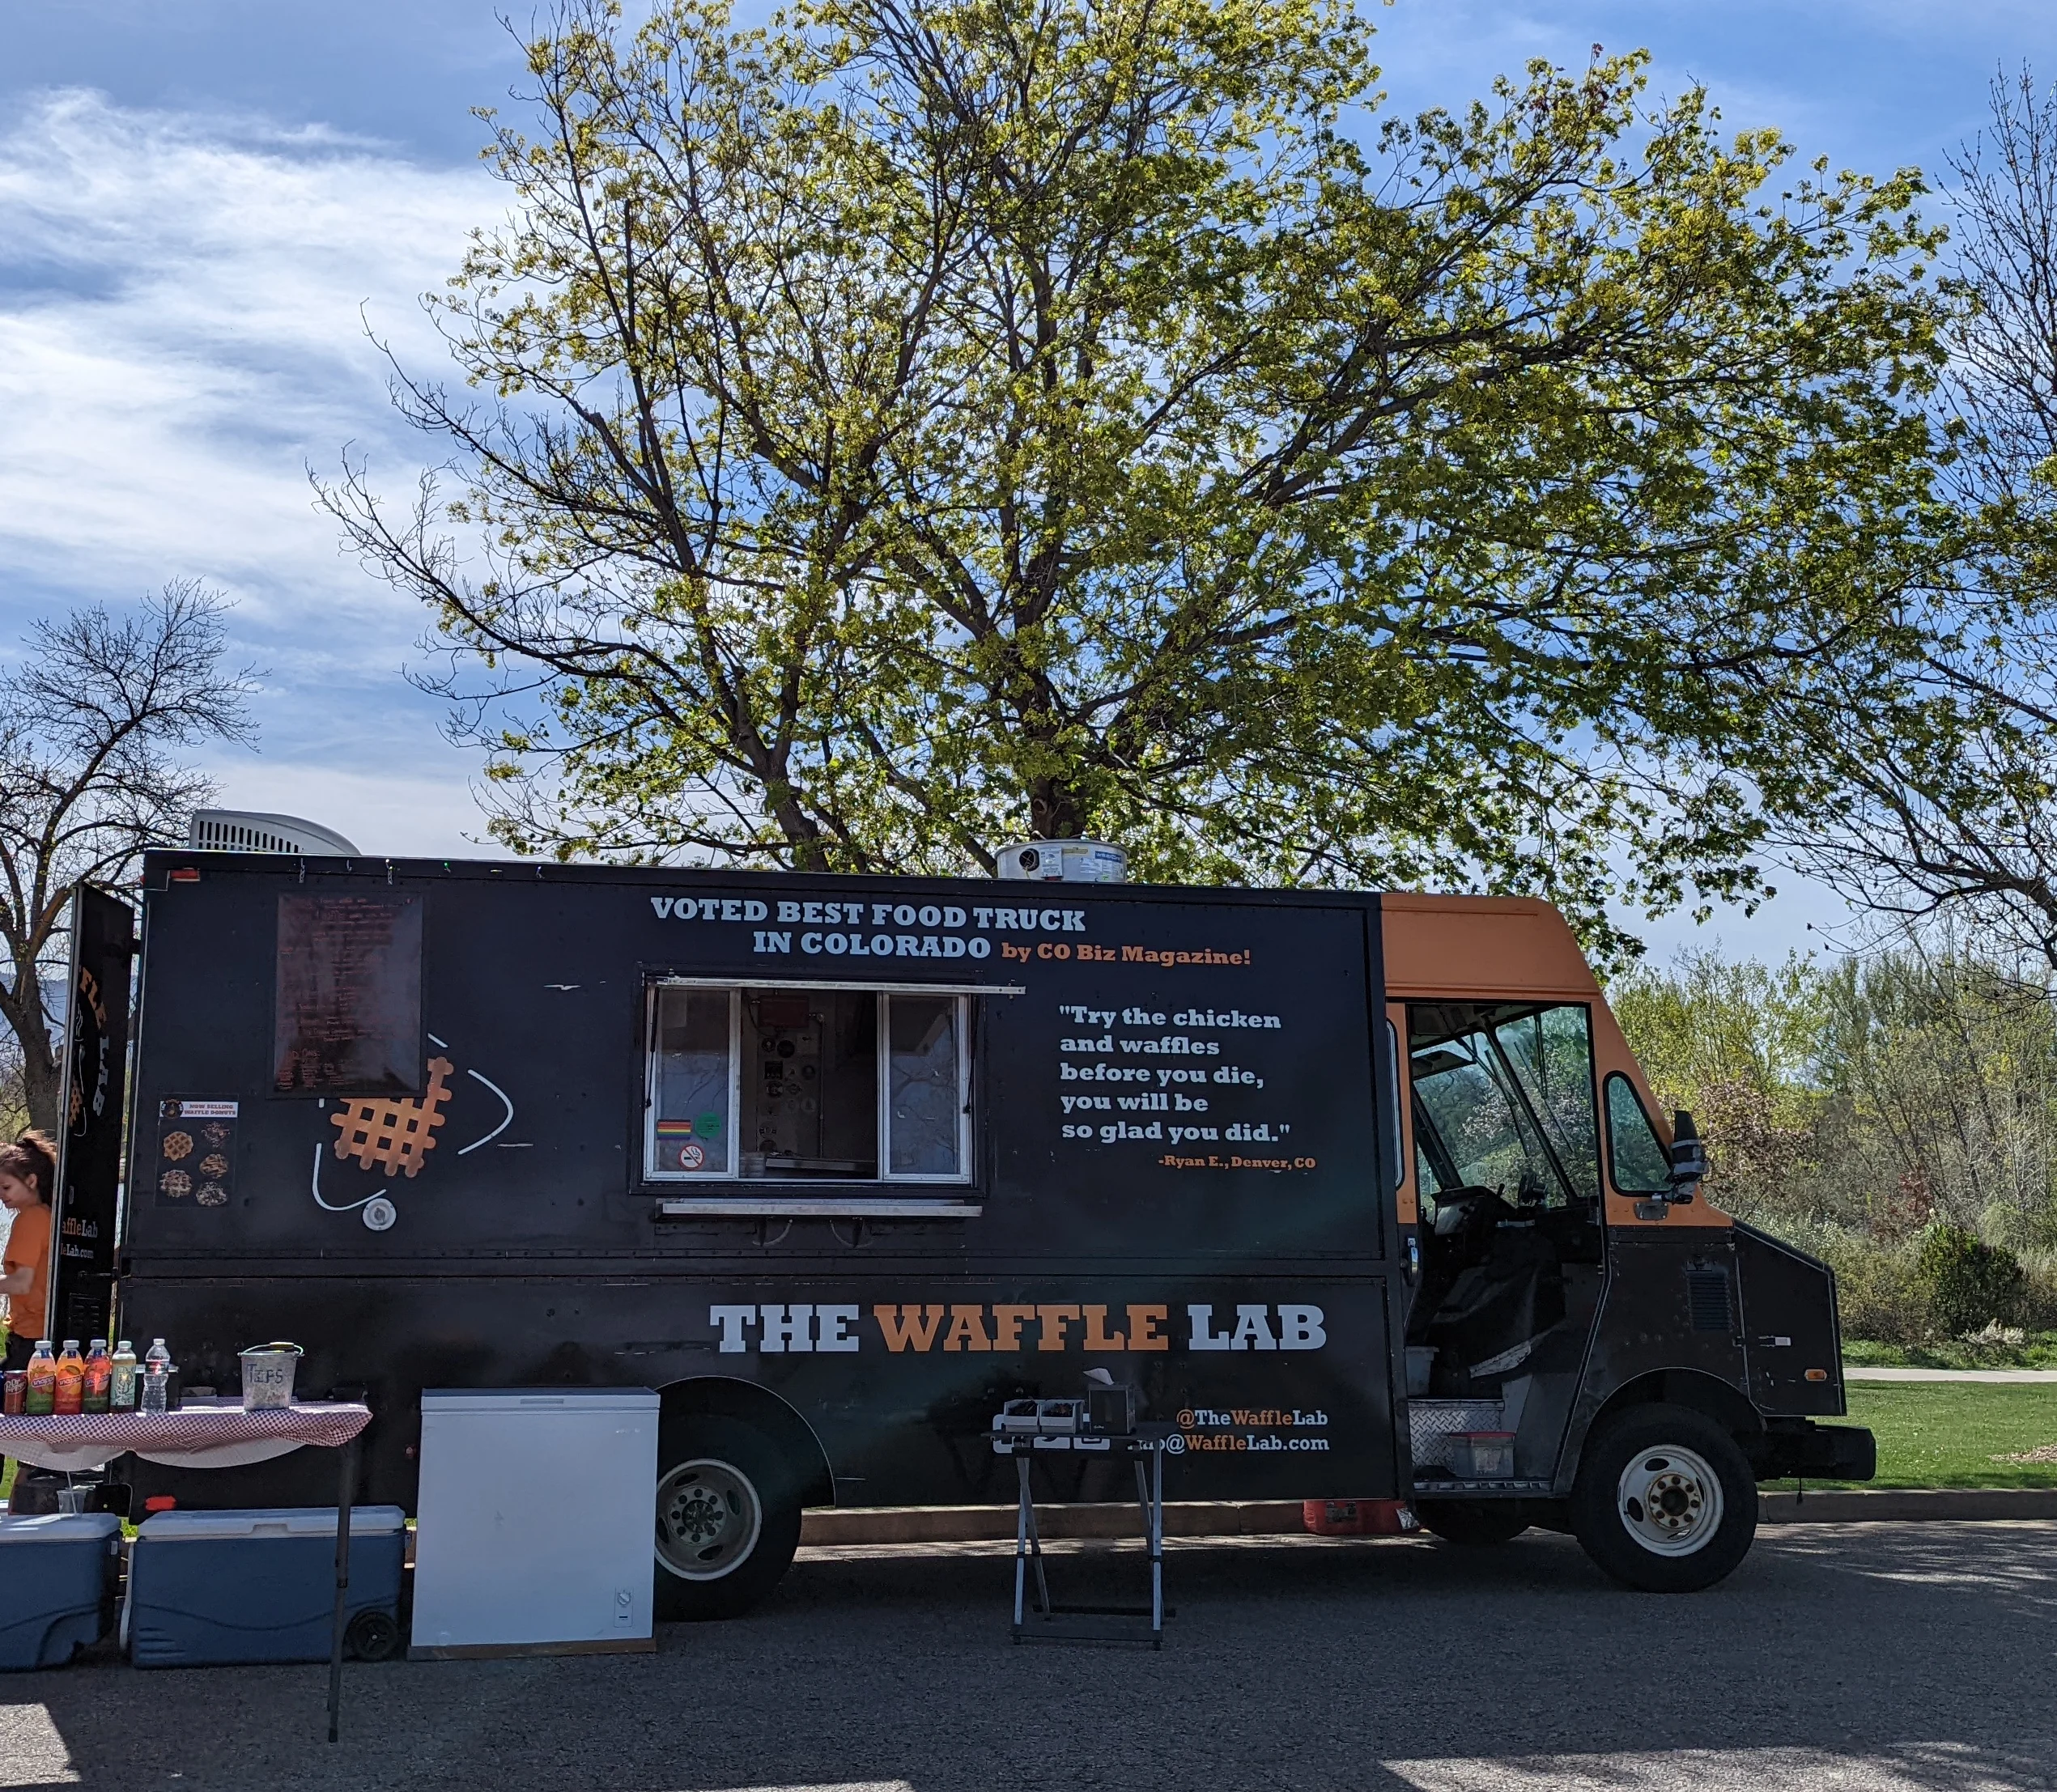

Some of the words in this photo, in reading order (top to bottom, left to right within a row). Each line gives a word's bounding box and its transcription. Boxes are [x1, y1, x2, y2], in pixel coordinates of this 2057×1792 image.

[651, 898, 767, 921] VOTED
[777, 902, 864, 924] BEST
[872, 904, 966, 927] FOOD
[973, 907, 1086, 931] TRUCK
[754, 932, 791, 953] IN
[801, 932, 990, 958] COLORADO
[1001, 942, 1031, 962] by
[1038, 944, 1070, 959] CO
[1077, 945, 1116, 961] Biz
[1122, 946, 1250, 966] Magazine!
[1060, 1005, 1116, 1029] "Try
[1122, 1008, 1166, 1025] the
[1173, 1009, 1281, 1028] chicken
[1060, 1035, 1113, 1051] and
[1120, 1037, 1219, 1055] waffles
[1060, 1063, 1150, 1081] before
[1157, 1070, 1206, 1086] you
[1213, 1067, 1263, 1089] die,
[1060, 1096, 1111, 1114] you
[1117, 1093, 1168, 1110] will
[1175, 1093, 1208, 1111] be
[1062, 1125, 1092, 1138] so
[1100, 1121, 1162, 1143] glad
[1168, 1127, 1218, 1144] you
[1226, 1123, 1290, 1141] did."
[1158, 1156, 1205, 1169] -Ryan
[1231, 1157, 1291, 1171] Denver,
[1294, 1157, 1315, 1168] CO
[710, 1305, 859, 1352] THE
[873, 1305, 1168, 1352] WAFFLE
[1188, 1305, 1326, 1350] LAB
[246, 1363, 283, 1383] TIPS
[1177, 1409, 1328, 1429] @TheWaffleLab
